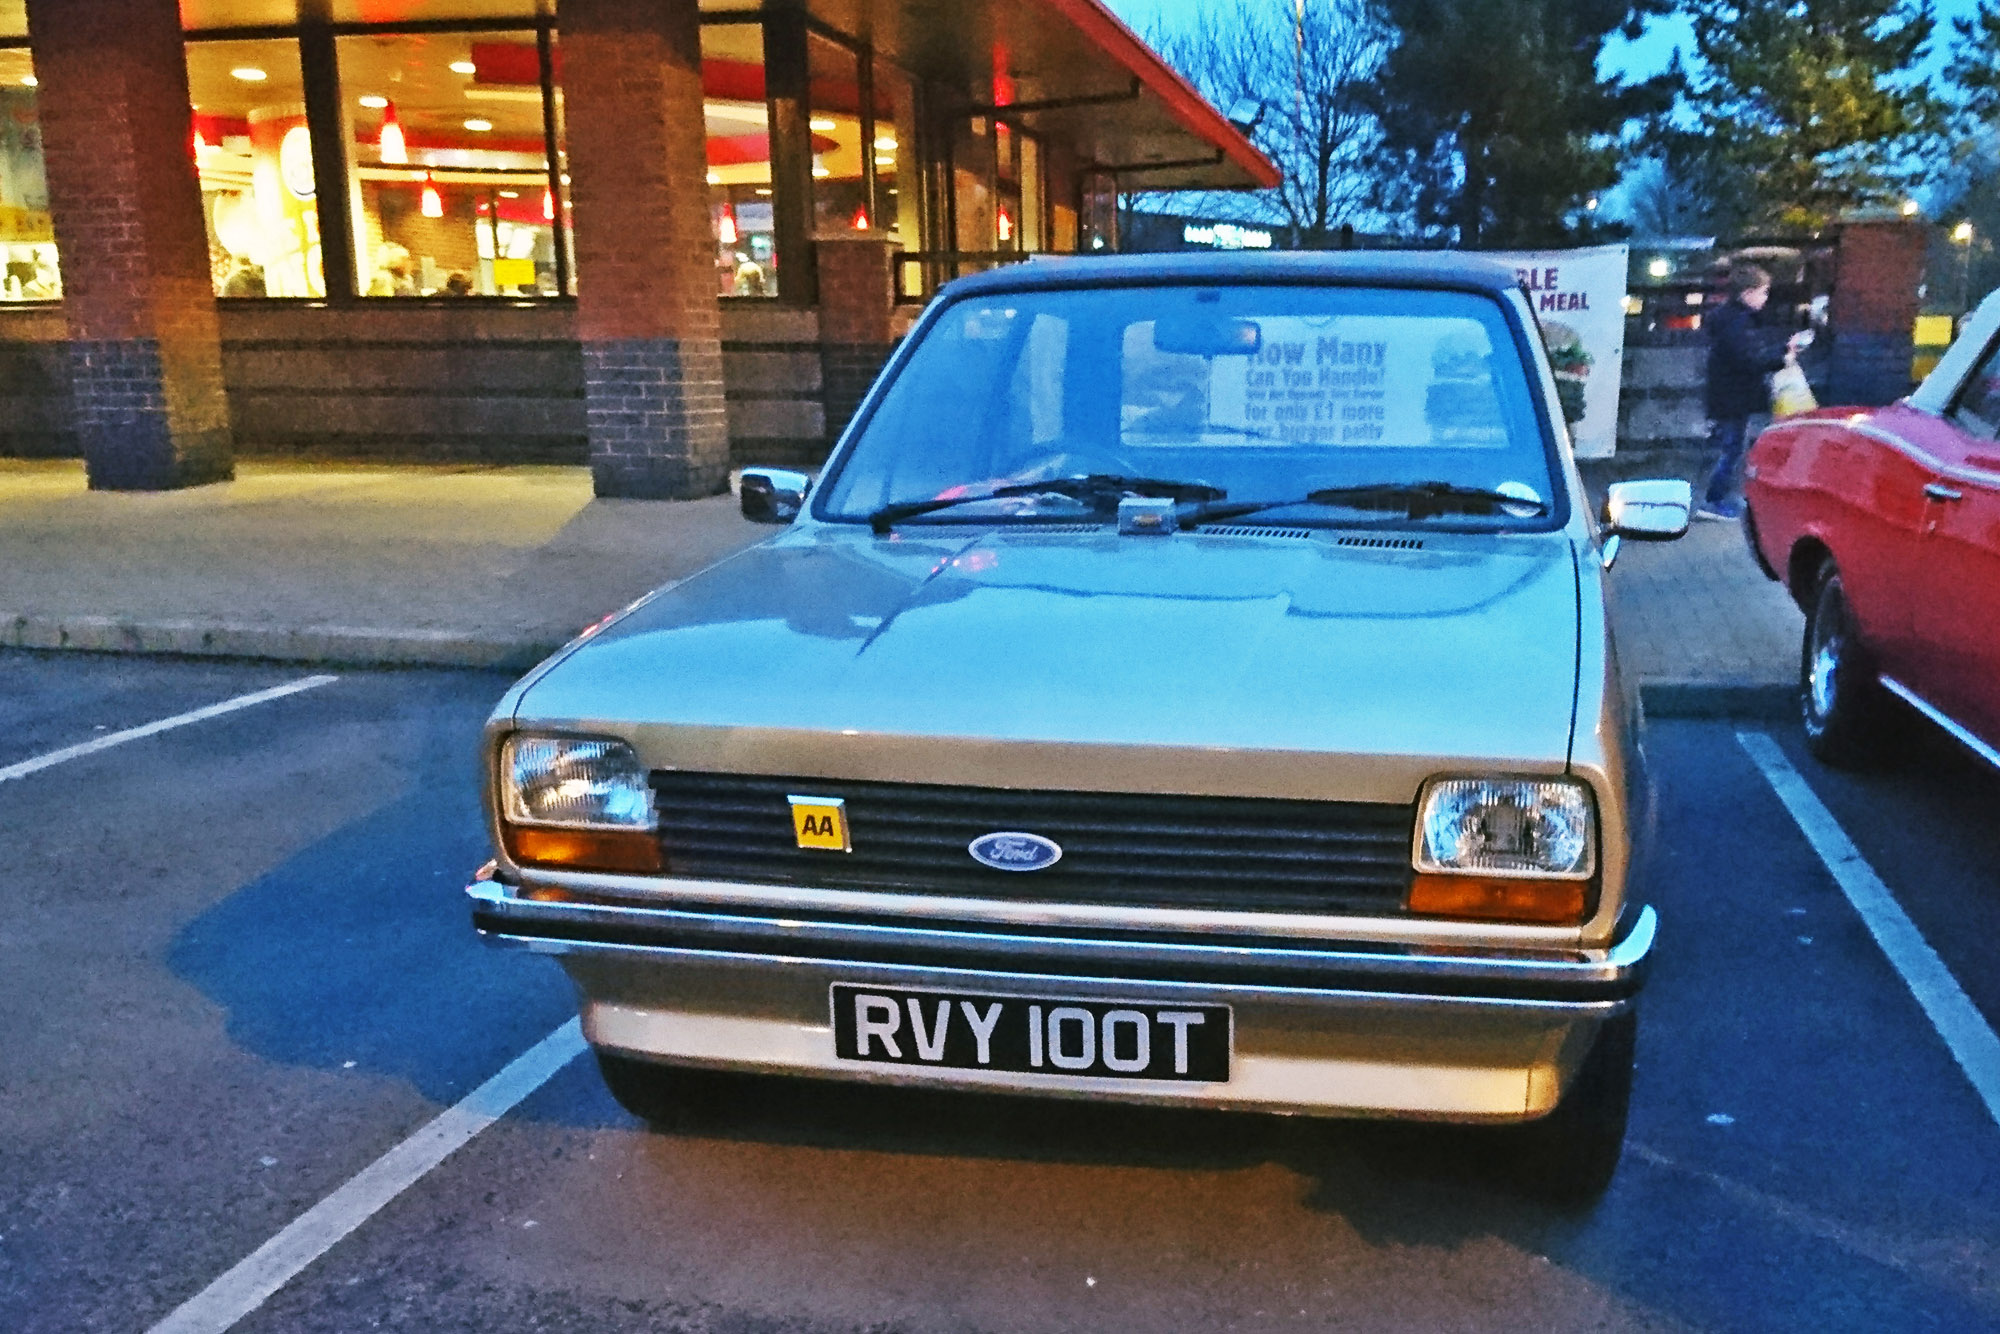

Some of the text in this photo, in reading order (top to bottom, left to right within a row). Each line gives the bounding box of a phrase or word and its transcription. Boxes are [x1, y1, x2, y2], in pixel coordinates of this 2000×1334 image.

[1540, 291, 1589, 312] MEAL
[1316, 336, 1387, 366] Many
[1245, 368, 1274, 386] Can
[1282, 368, 1313, 386] You
[1245, 400, 1385, 421] for only £1 more
[1343, 424, 1385, 441] patty
[801, 814, 834, 837] AA
[990, 837, 1037, 861] Ford
[854, 994, 1205, 1074] RVY 100T
